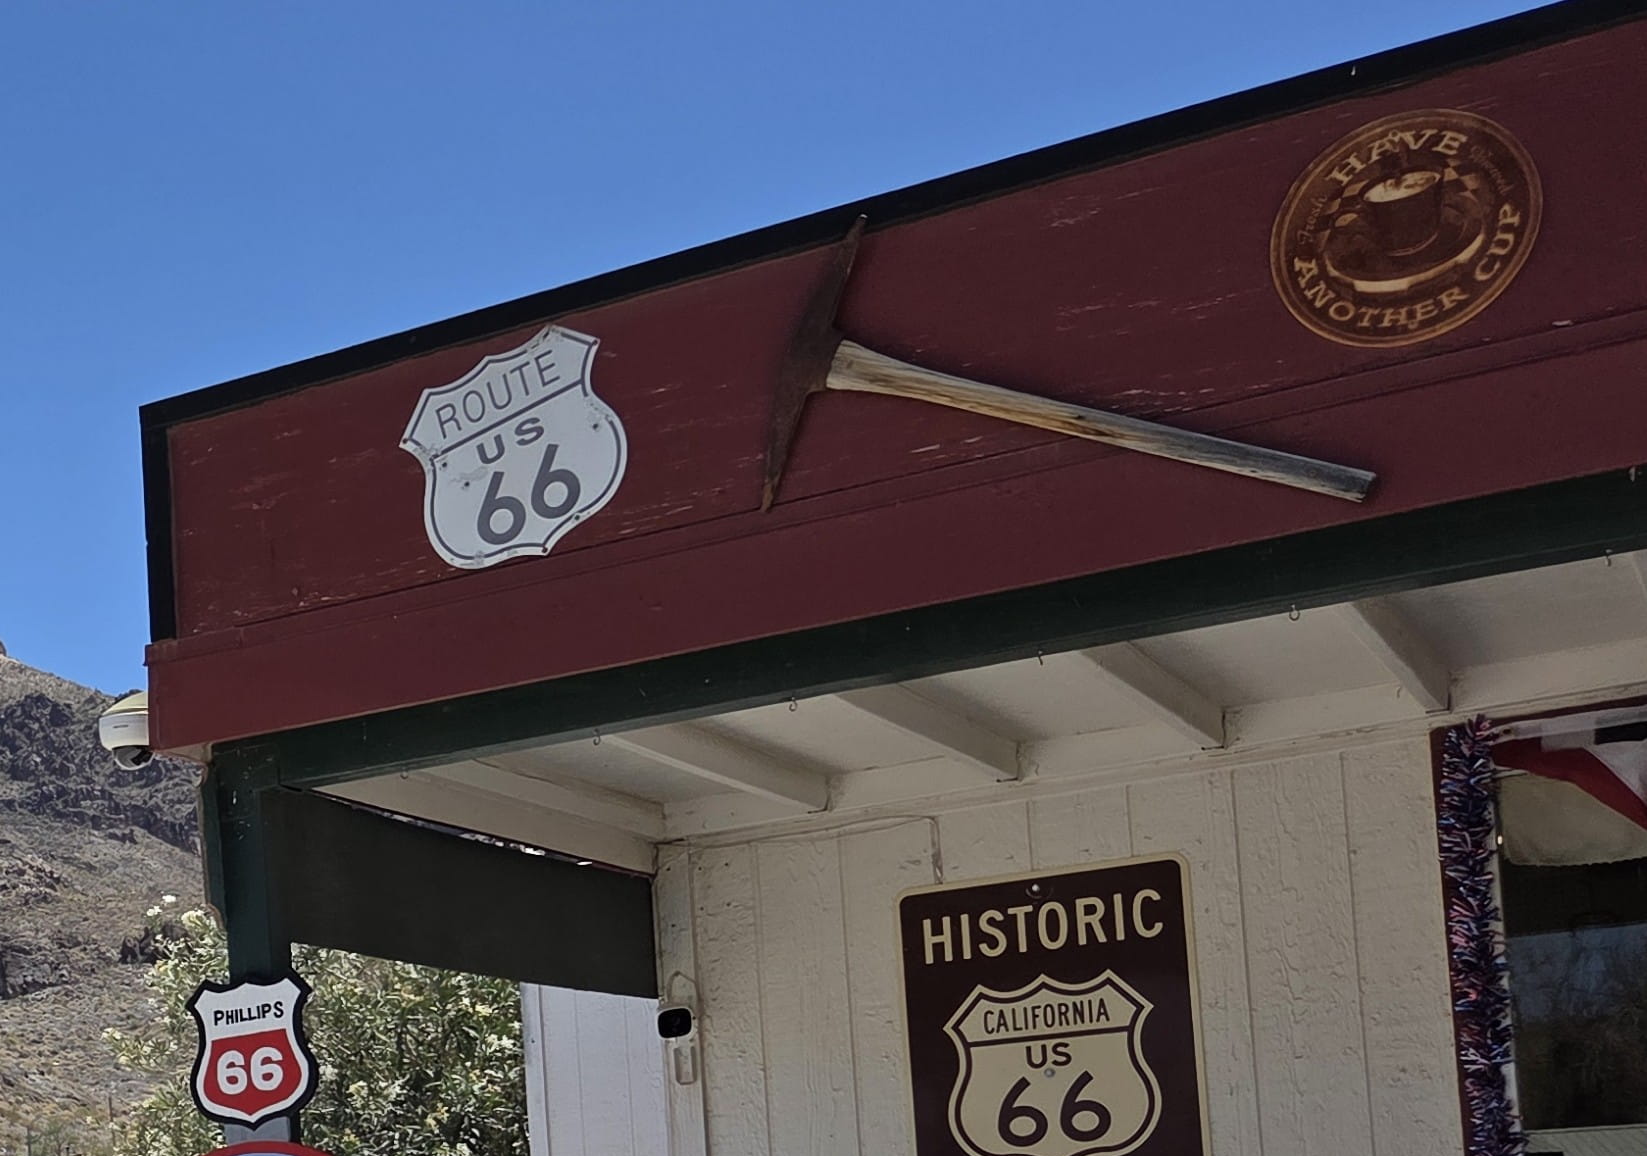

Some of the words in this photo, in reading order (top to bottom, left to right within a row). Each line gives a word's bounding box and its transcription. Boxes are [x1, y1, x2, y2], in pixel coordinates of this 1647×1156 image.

[1326, 129, 1469, 186] HAVE
[1293, 255, 1470, 330] ANOTHER
[1473, 202, 1521, 281] CUP
[435, 350, 561, 440] ROUTE
[476, 416, 545, 465] US
[476, 443, 582, 546] 66
[921, 888, 1165, 966] HISTORIC
[213, 1000, 285, 1027] PHILLIPS
[982, 997, 1111, 1035] CALIFORNIA
[216, 1046, 284, 1095] 66
[1025, 1042, 1073, 1070] US
[997, 1069, 1112, 1148] 66
